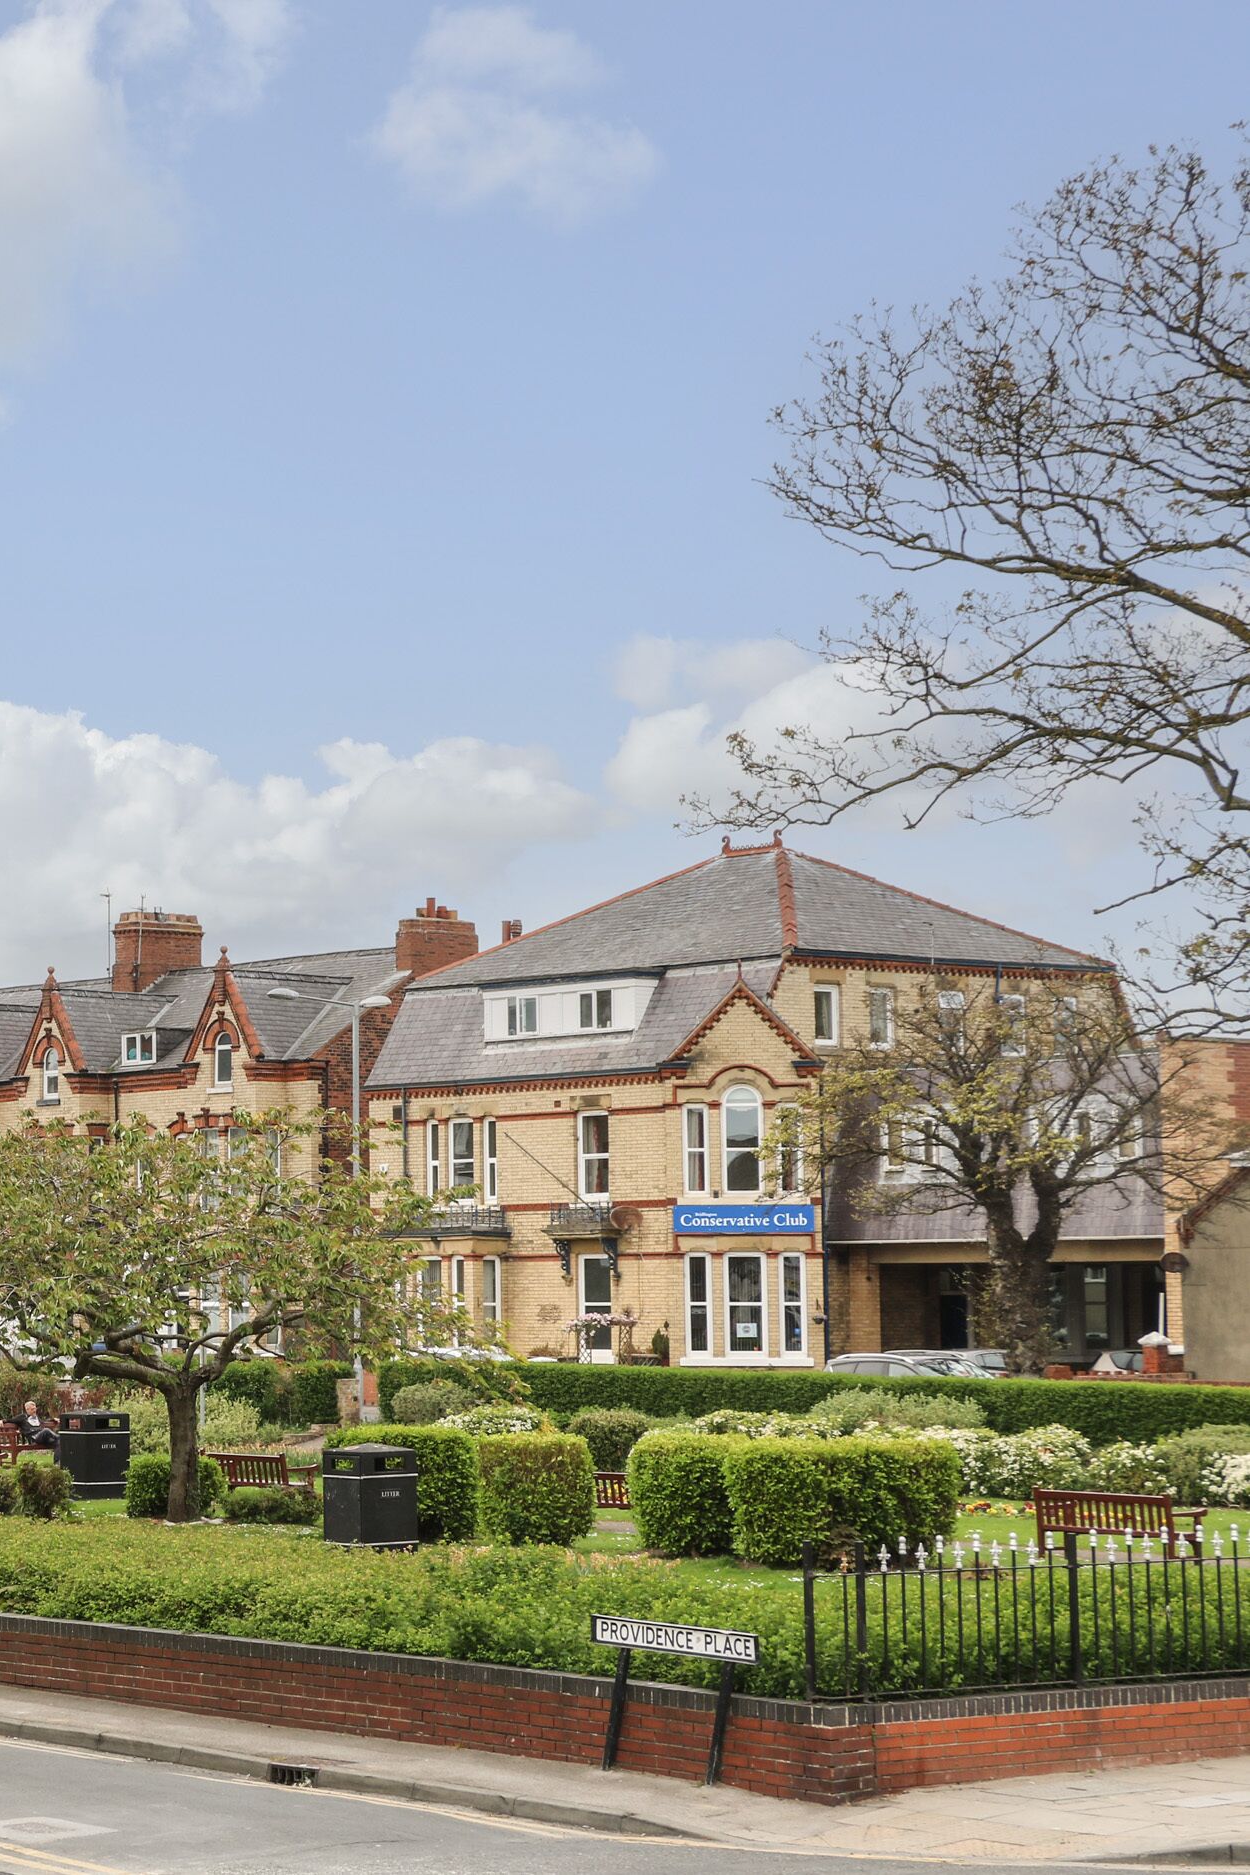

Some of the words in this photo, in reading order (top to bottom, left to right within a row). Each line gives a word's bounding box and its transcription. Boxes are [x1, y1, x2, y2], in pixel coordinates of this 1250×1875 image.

[680, 1213, 770, 1227] Conservative
[773, 1212, 808, 1226] Club
[600, 1621, 694, 1650] PROVIDENCE
[704, 1634, 753, 1658] PLACE
